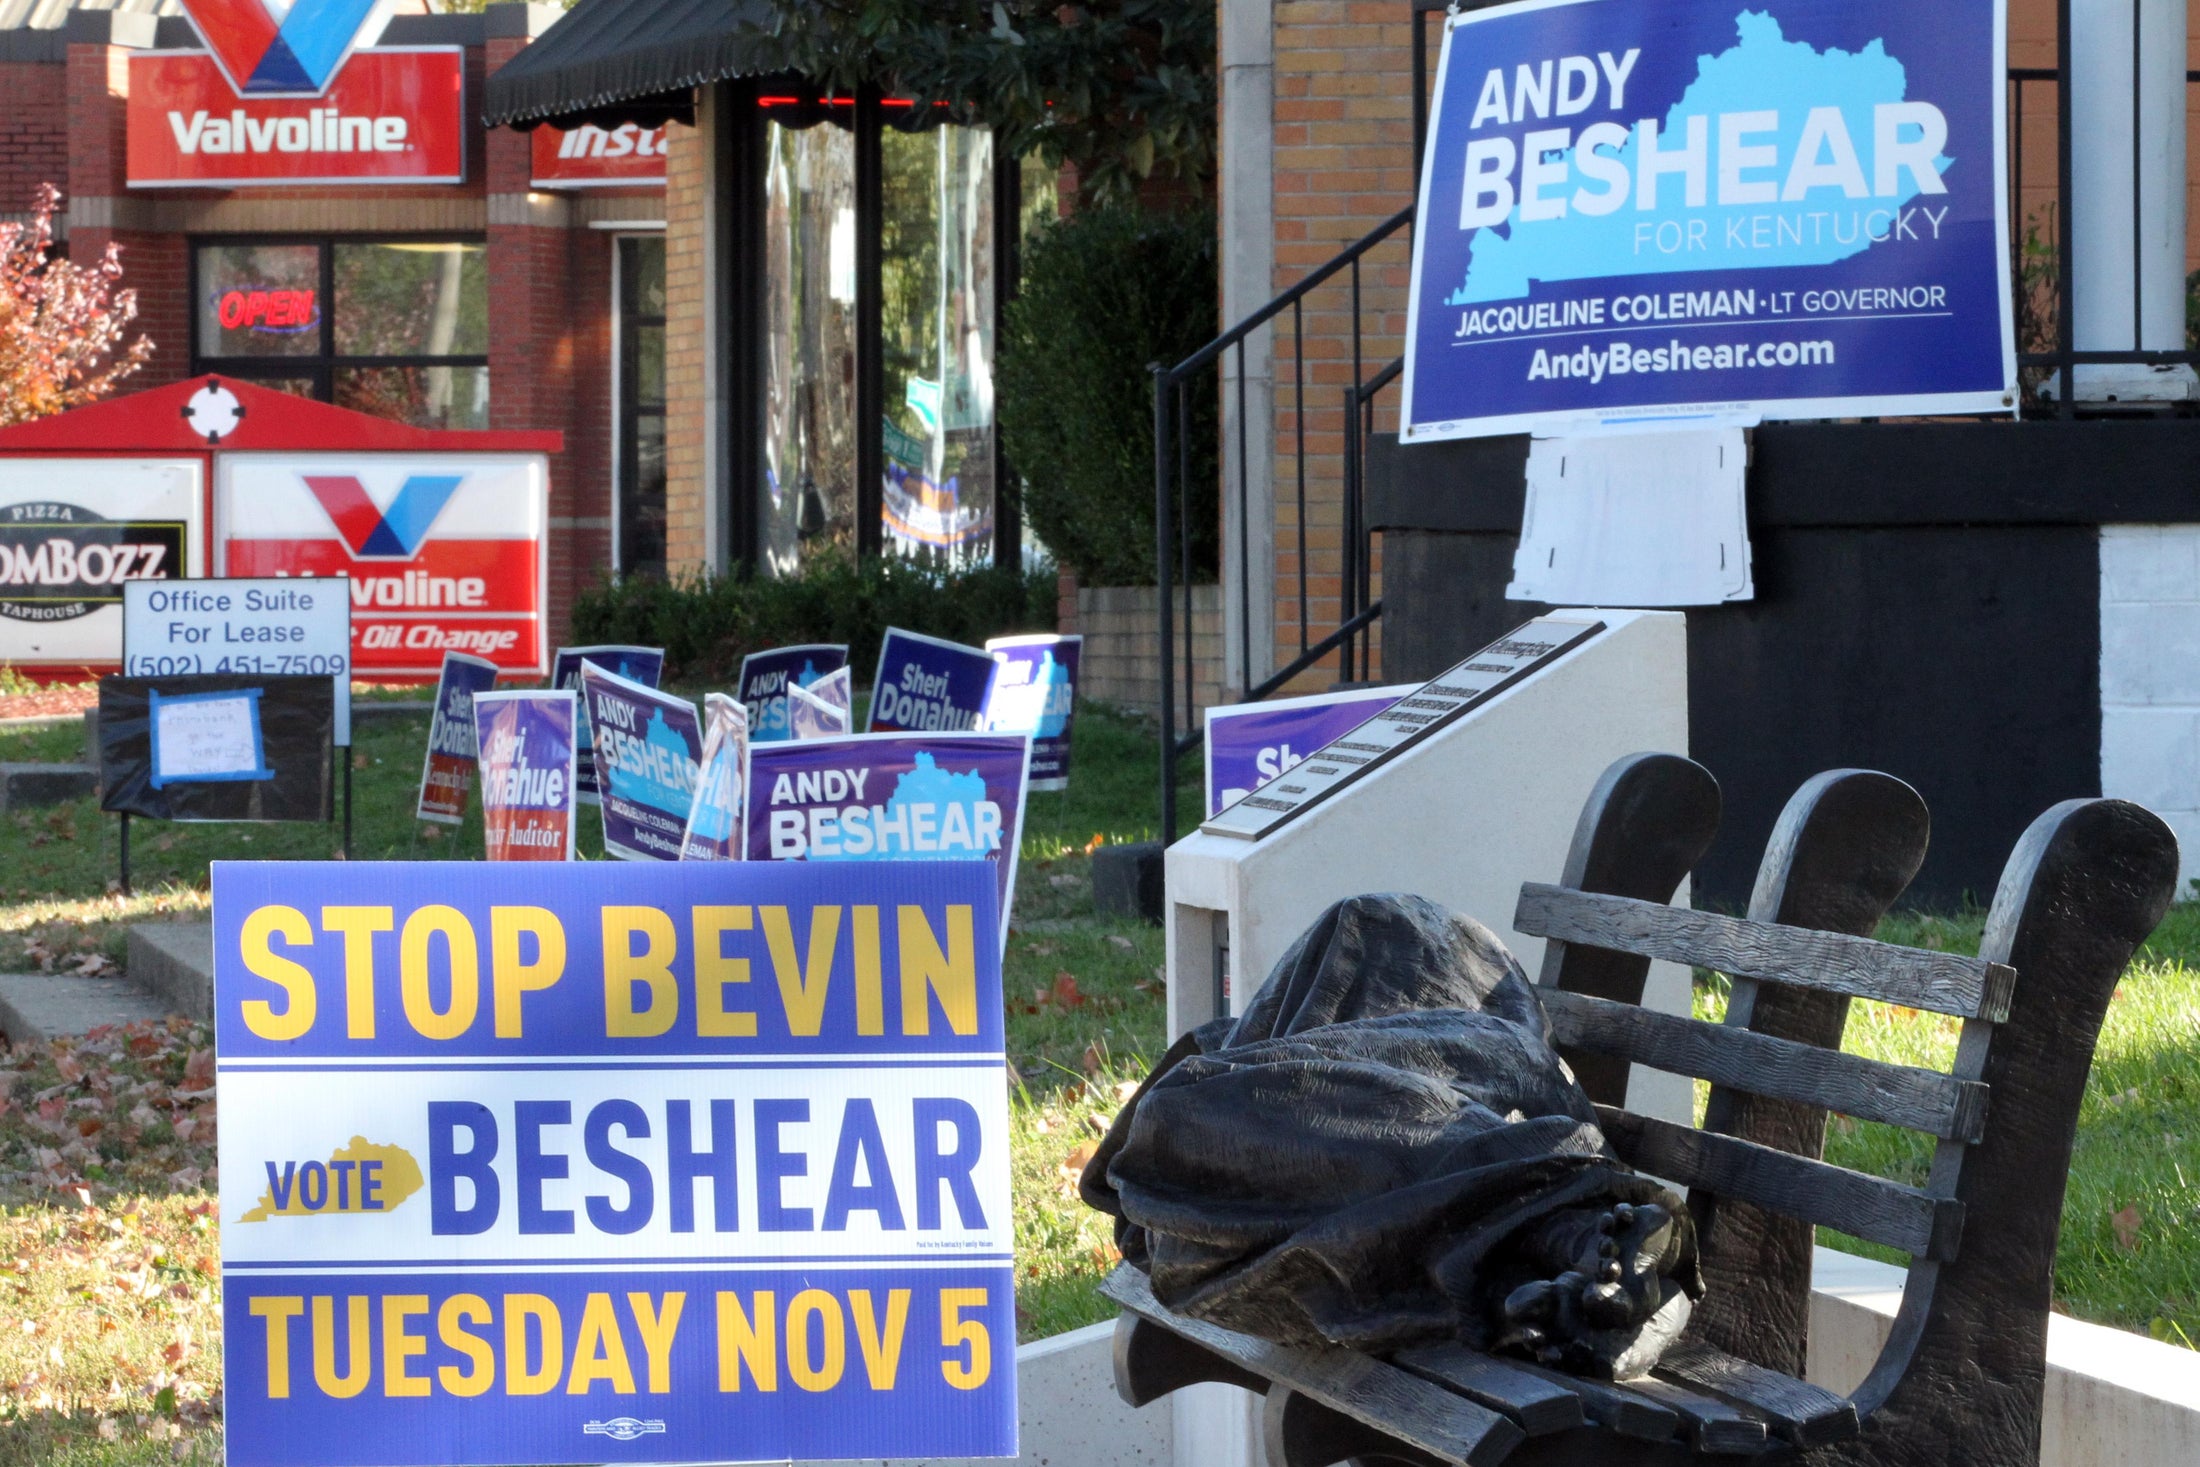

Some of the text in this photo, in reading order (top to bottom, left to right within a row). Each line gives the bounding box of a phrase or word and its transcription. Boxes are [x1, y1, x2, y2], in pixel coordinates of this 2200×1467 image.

[1470, 48, 1641, 129] ANDY
[167, 108, 408, 154] Valvoline
[1459, 101, 1949, 230] BESHEAR
[1634, 206, 1949, 255] FOR KENTUCKY
[218, 290, 315, 330] OPEN
[1455, 286, 1946, 338] JACQUELINE COLEMAN LT GOVERNOR
[1527, 339, 1835, 383] AndyBeshear.com
[12, 504, 74, 521] PIZZA
[149, 590, 314, 612] Office Suite
[169, 622, 305, 643] For Lease
[361, 625, 403, 649] Oil
[405, 625, 519, 653] Change
[129, 655, 346, 676] (502) 451-7509
[748, 670, 788, 697] ANDY
[901, 663, 950, 699] Sheri
[597, 694, 636, 732] ANDY
[771, 768, 869, 805] ANDY
[508, 820, 560, 847] Auditor
[770, 801, 1002, 858] BESHEAR
[240, 904, 979, 1041] STOP BEVIN
[265, 1097, 988, 1233] VOTE BESHEAR
[249, 1287, 991, 1399] TUESDAY NOV 5
